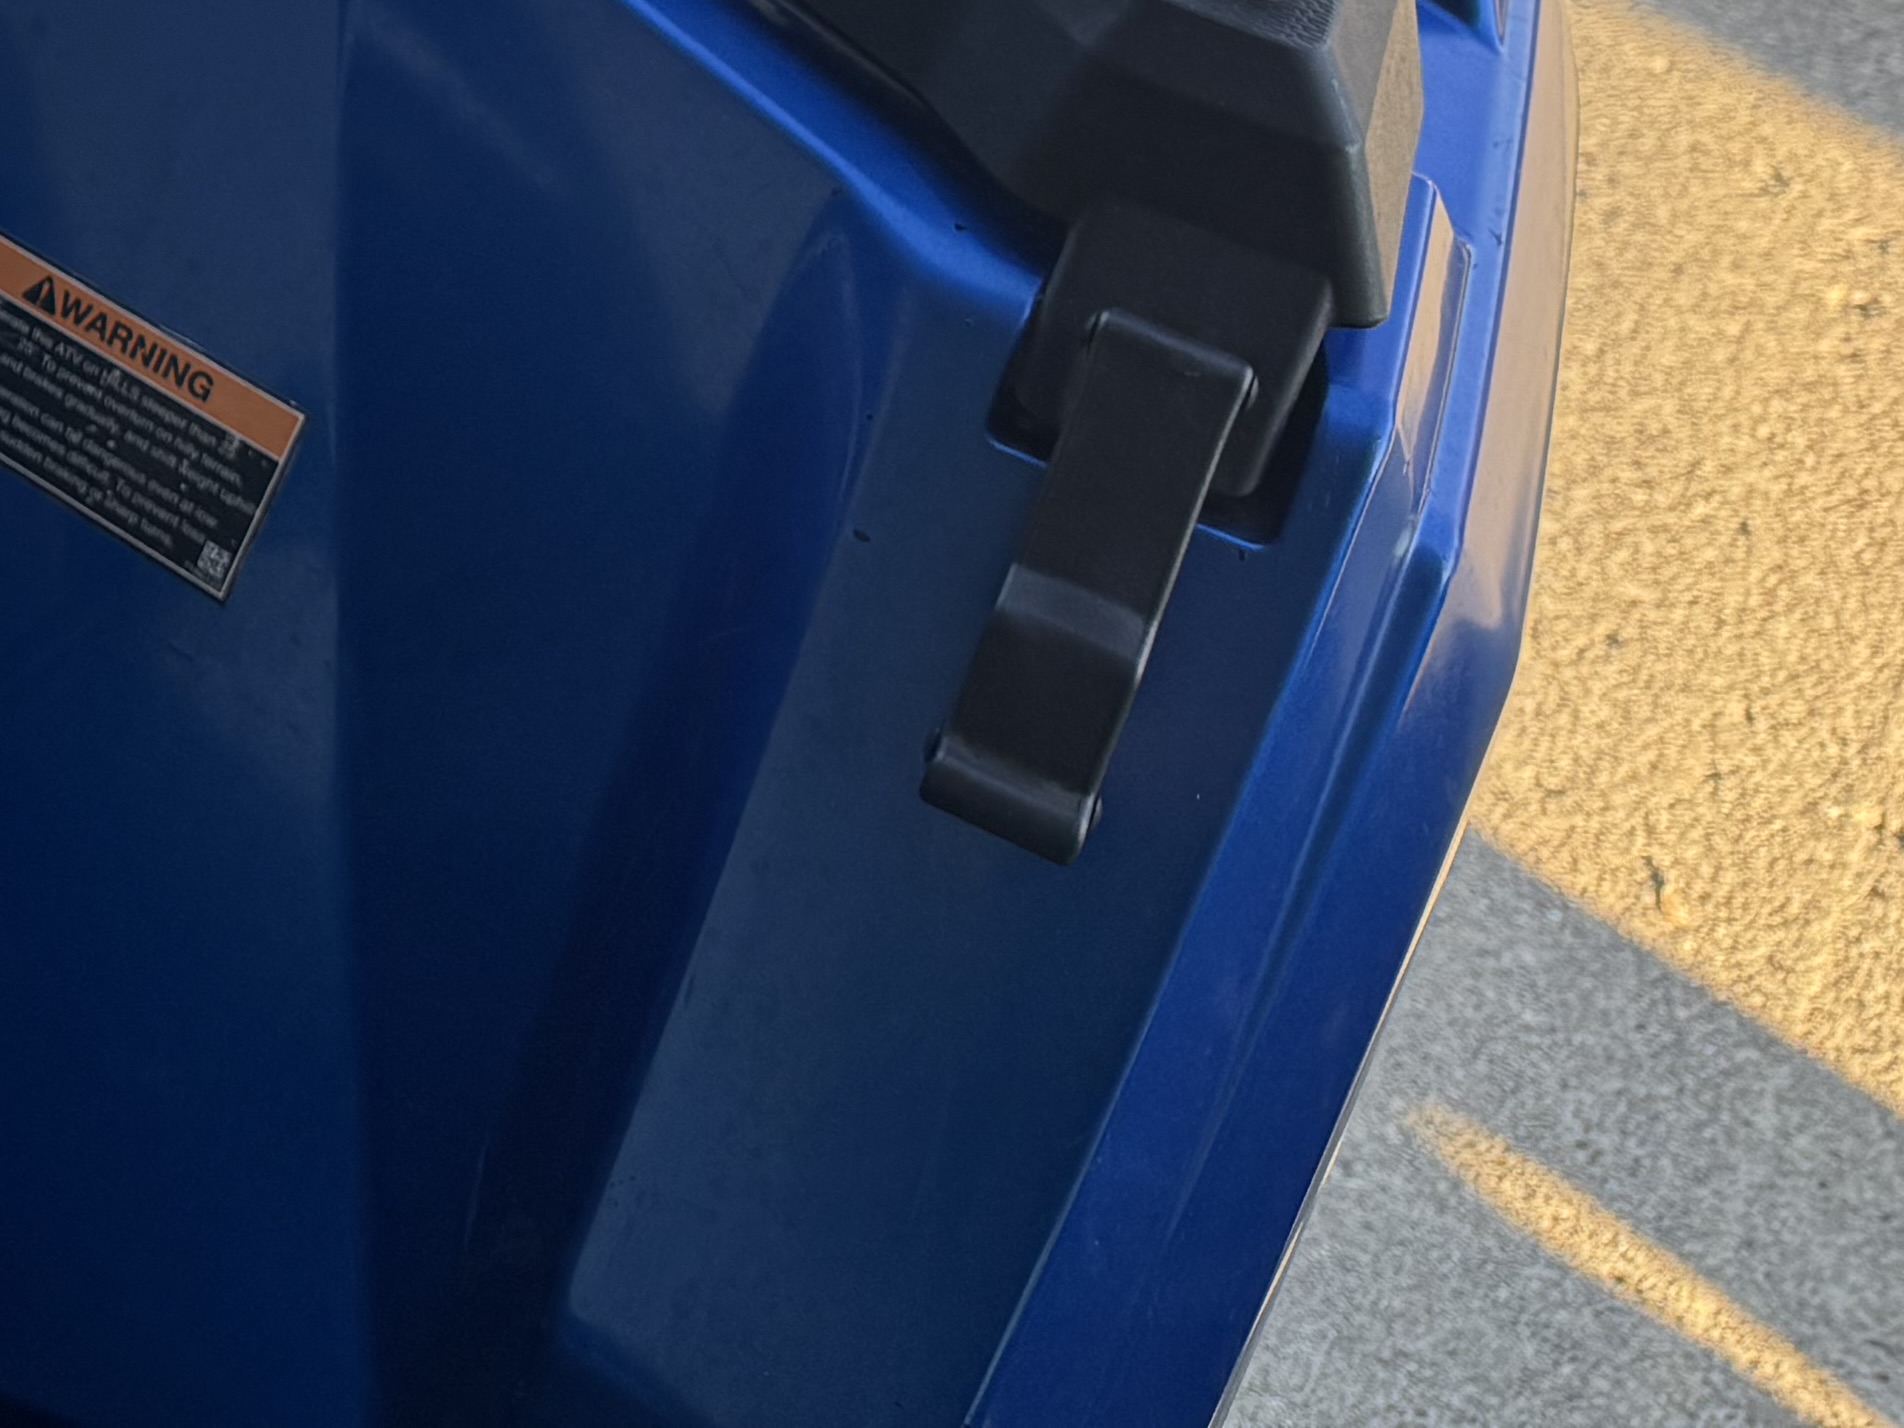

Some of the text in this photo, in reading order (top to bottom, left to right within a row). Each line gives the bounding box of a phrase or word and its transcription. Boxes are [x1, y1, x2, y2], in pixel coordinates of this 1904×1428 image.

[54, 342, 82, 364] ATV
[61, 291, 213, 401] WARNING
[41, 353, 56, 372] To
